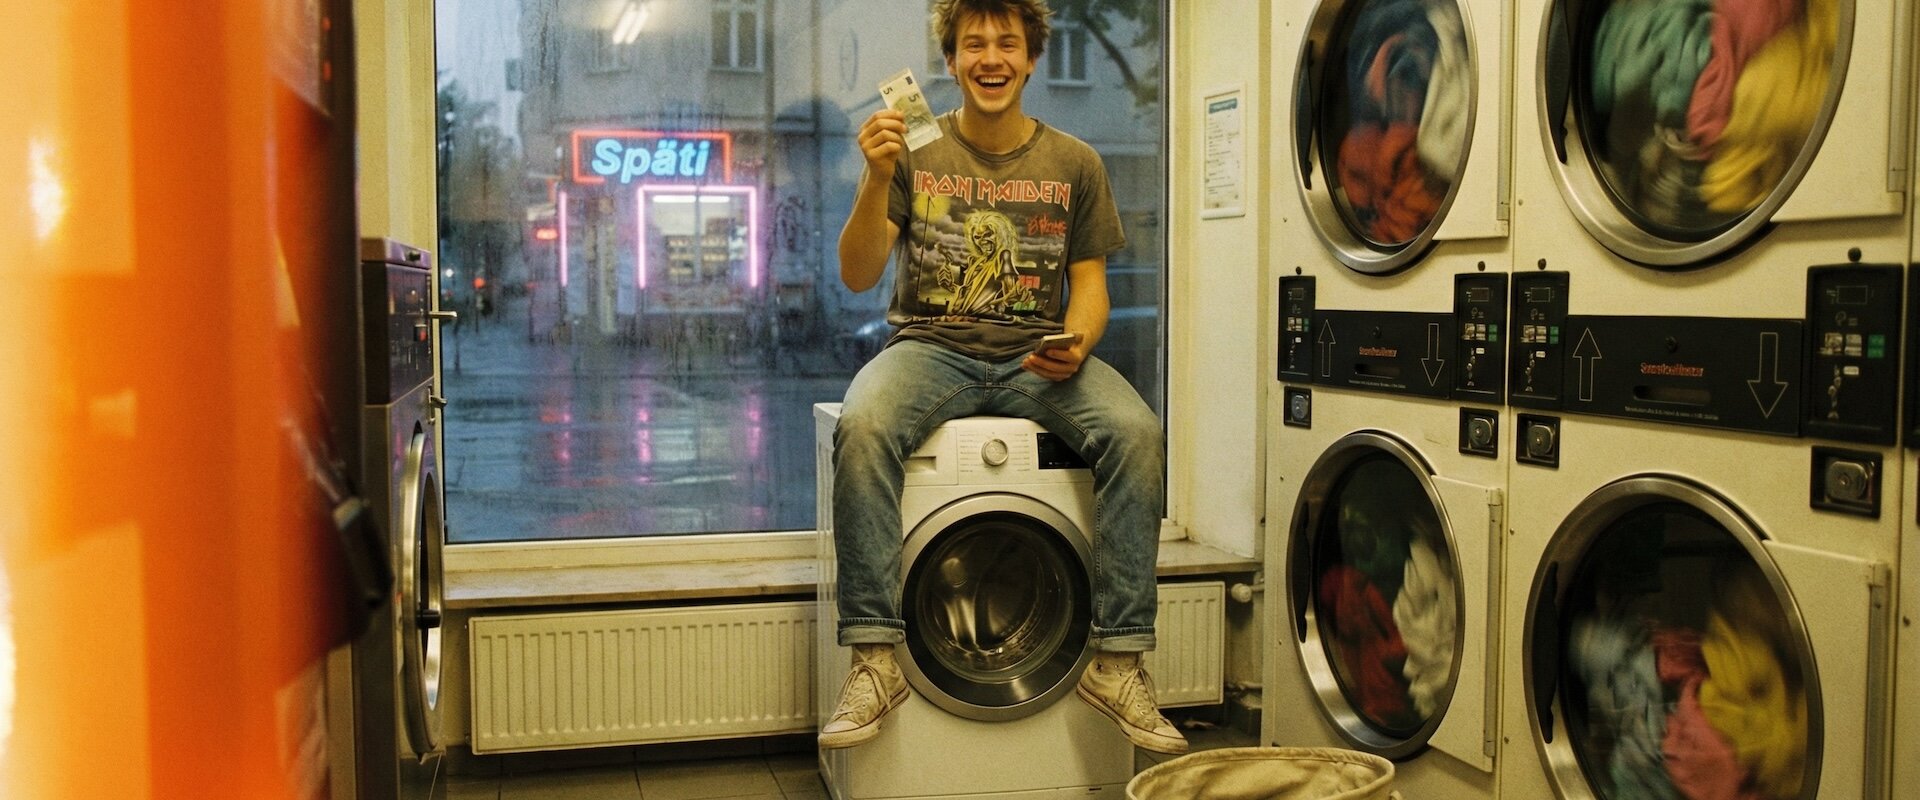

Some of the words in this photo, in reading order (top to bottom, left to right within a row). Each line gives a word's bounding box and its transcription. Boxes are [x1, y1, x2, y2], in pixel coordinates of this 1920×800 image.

[883, 87, 893, 95] 5
[908, 93, 920, 103] 5
[591, 138, 710, 184] Späti
[913, 170, 973, 206] IRON
[976, 177, 1071, 212] MAIDEN
